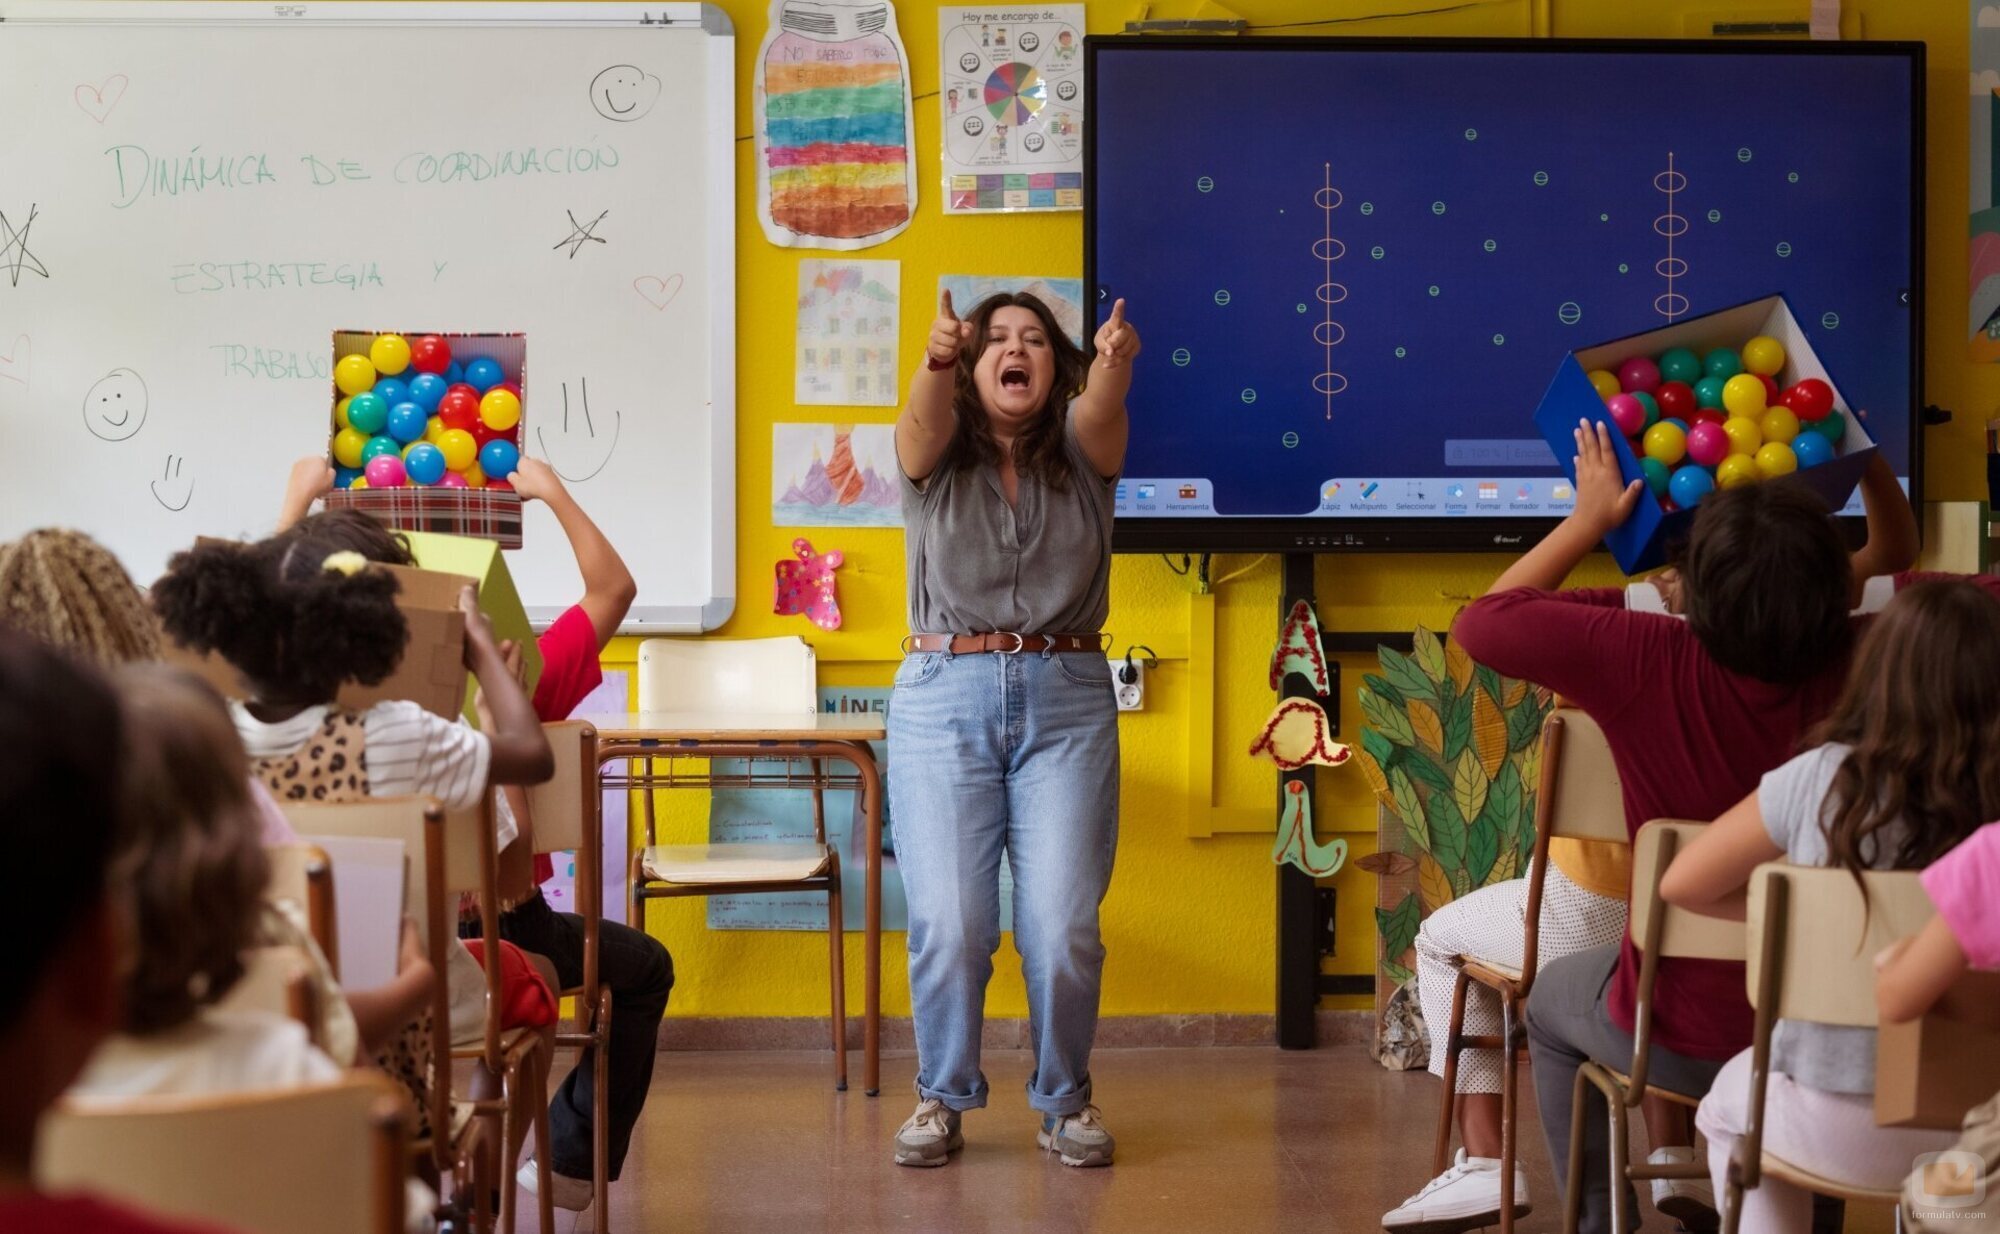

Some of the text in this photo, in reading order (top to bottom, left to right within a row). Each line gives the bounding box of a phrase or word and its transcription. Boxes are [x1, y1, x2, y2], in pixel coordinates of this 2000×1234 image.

[962, 11, 982, 23] Hoy
[984, 13, 998, 21] me
[1001, 12, 1039, 23] encargo
[783, 46, 804, 63] NO
[104, 145, 276, 208] DINÁMICA
[301, 154, 372, 185] DE
[170, 261, 384, 294] ESTRATEGIA
[1322, 503, 1341, 511] Lápiz
[1350, 503, 1388, 511] Multipunto
